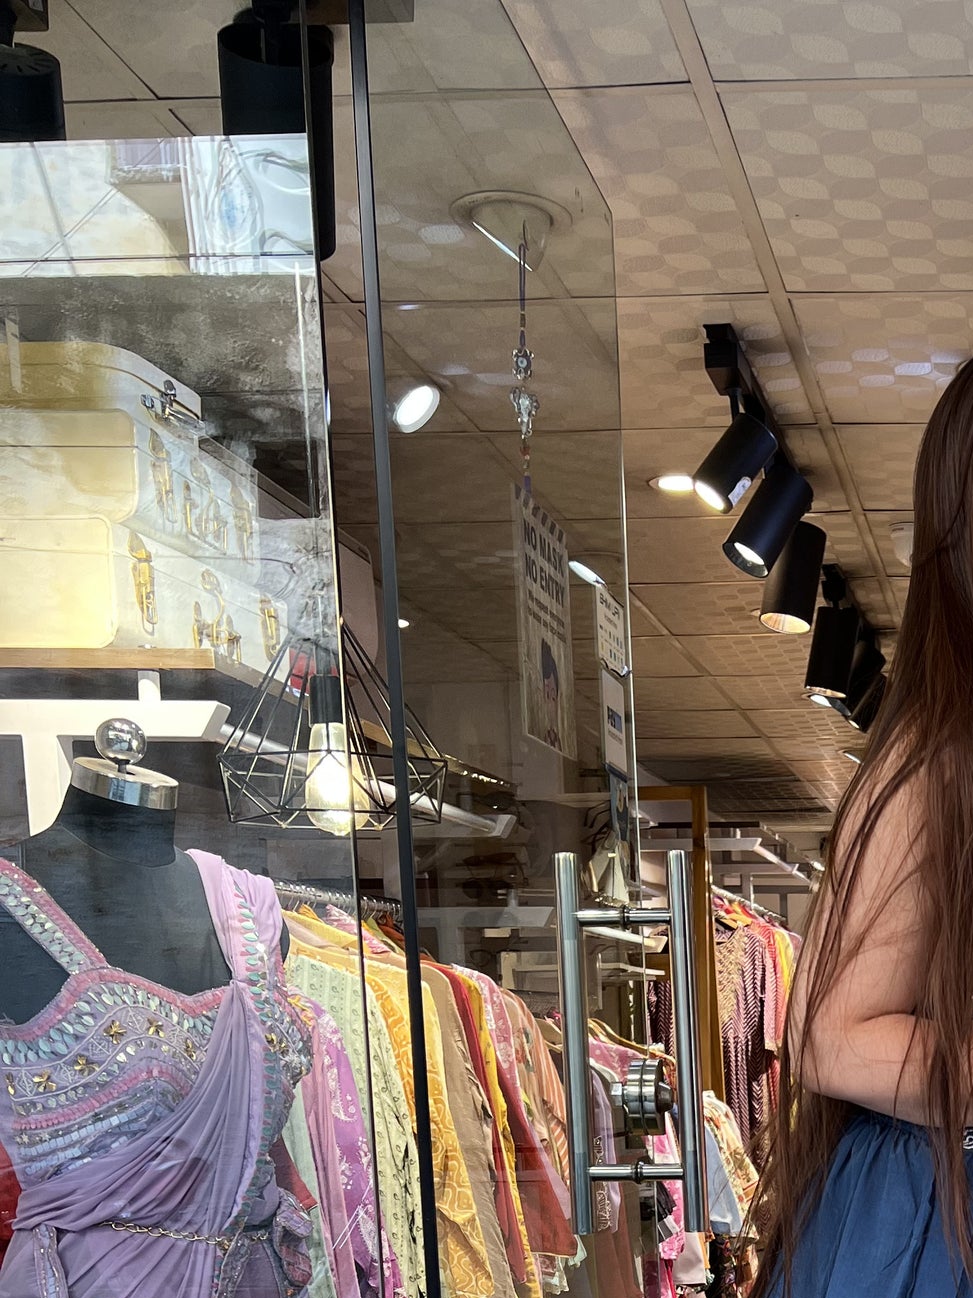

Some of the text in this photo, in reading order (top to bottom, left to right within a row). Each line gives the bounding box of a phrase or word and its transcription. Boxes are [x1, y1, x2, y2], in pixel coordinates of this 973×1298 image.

[523, 518, 565, 578] NO MASK
[525, 552, 565, 608] NO ENTRY
